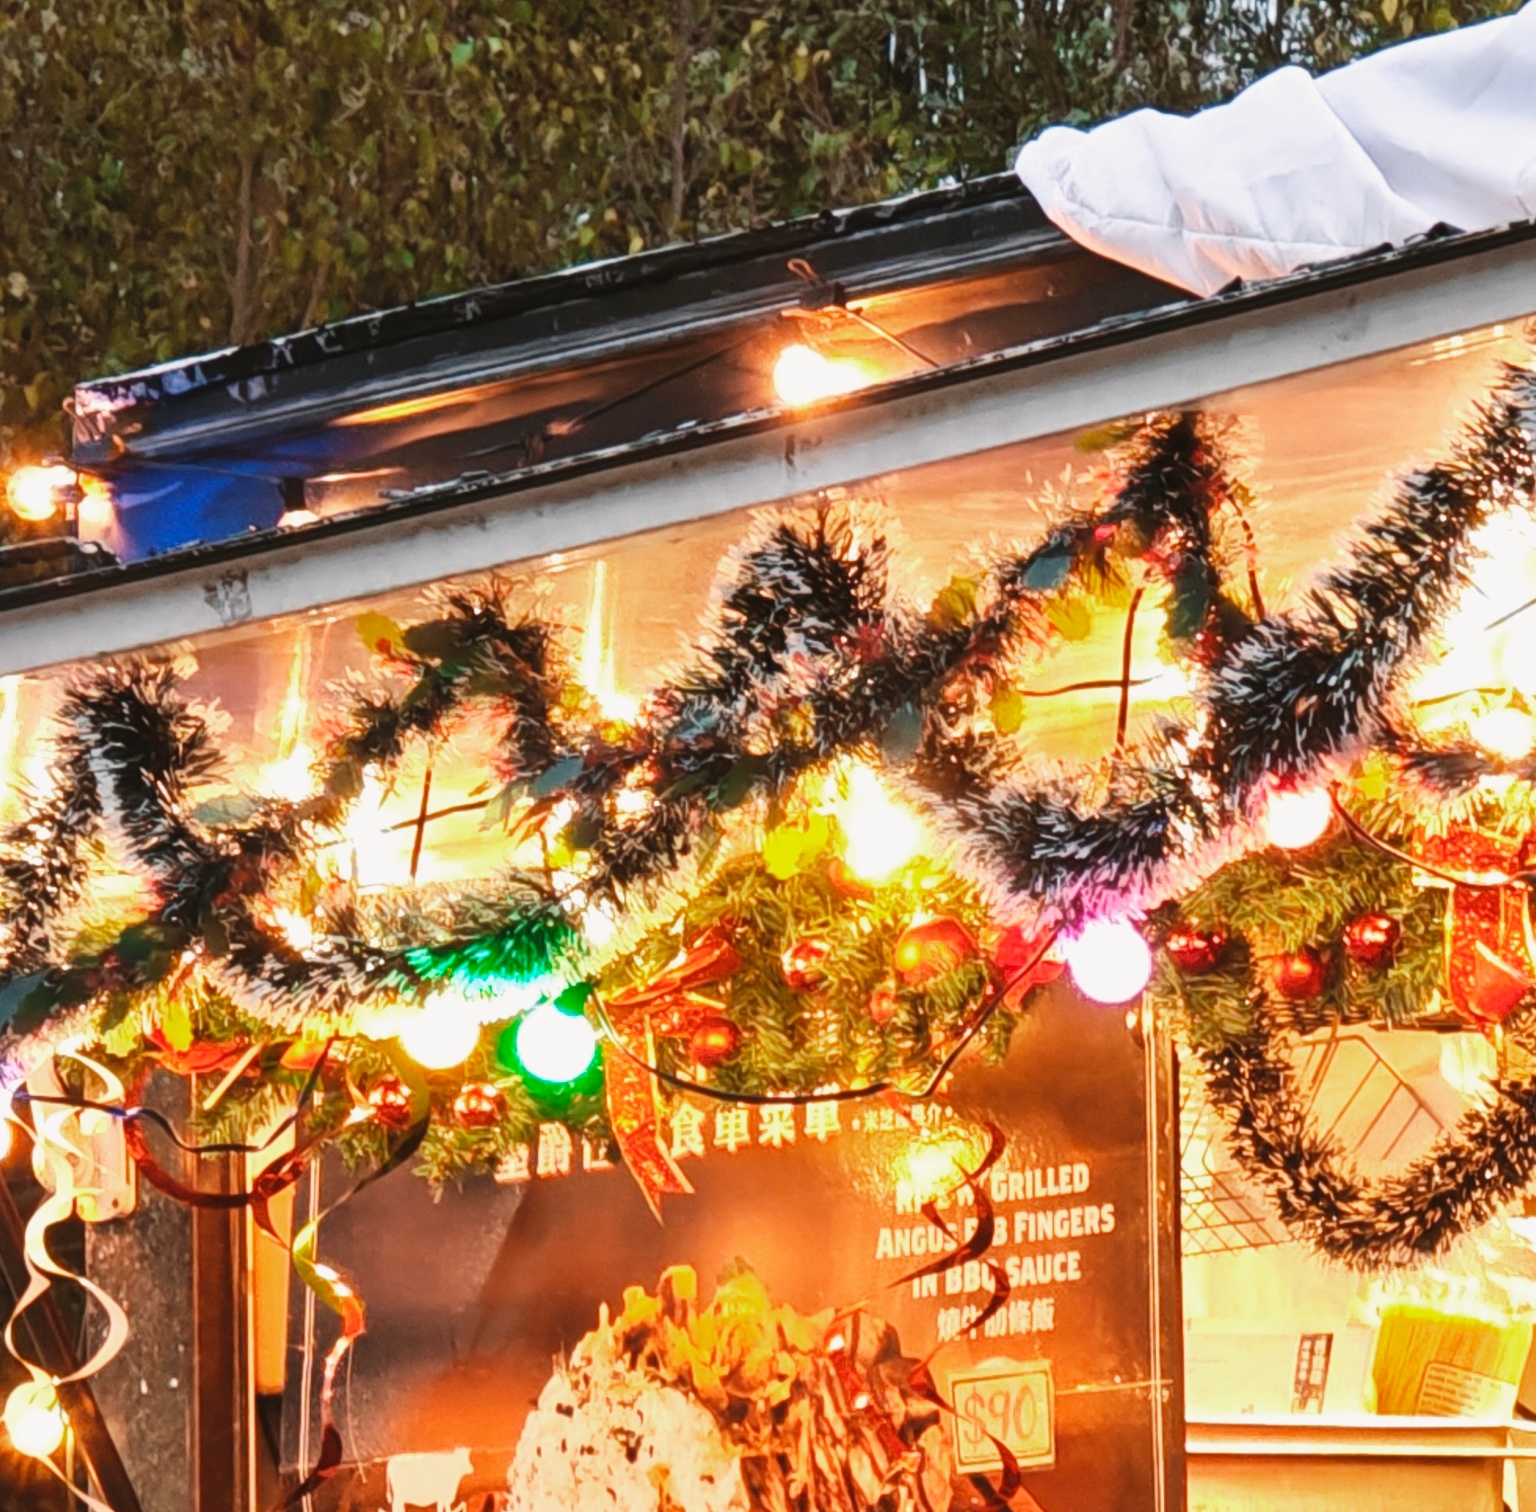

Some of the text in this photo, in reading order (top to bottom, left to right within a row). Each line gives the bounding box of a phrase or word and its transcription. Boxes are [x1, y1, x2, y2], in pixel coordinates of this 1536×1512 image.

[991, 1163, 1089, 1203] GRILLED
[876, 1204, 1115, 1259] ANGUS FINGERS
[1005, 1251, 1081, 1288] SAUCE
[963, 1384, 1038, 1451] $90
